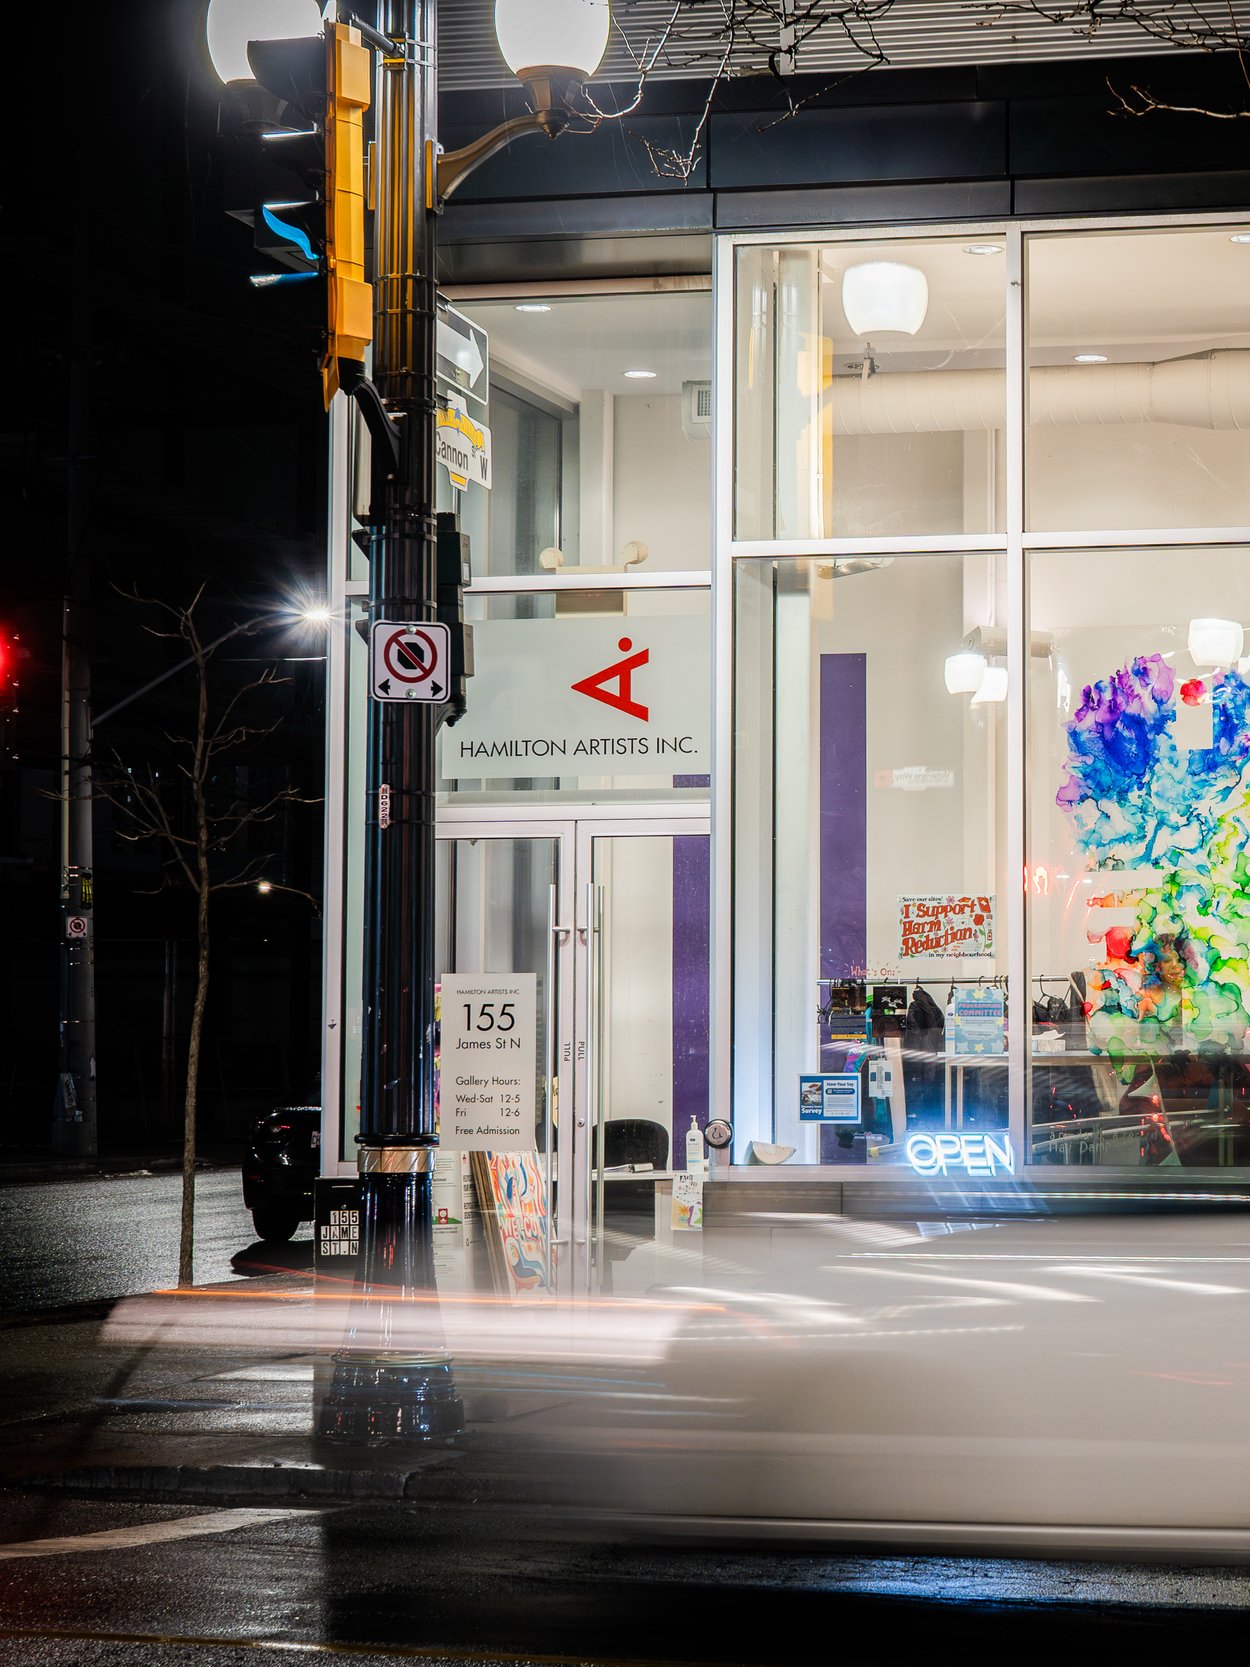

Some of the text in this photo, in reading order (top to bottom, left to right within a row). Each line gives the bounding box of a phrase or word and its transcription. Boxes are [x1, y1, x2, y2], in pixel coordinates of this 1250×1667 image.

[480, 456, 488, 480] W
[460, 736, 698, 758] HAMILTON ARTISTS INC.
[904, 900, 976, 920] I Support
[902, 920, 941, 937] Harm
[902, 926, 972, 956] Reduction
[851, 966, 895, 976] What's On:
[463, 1004, 515, 1031] 155
[456, 1038, 520, 1050] James St N
[456, 1076, 520, 1088] Gallery Hours:
[456, 1094, 520, 1103] Wed-Sat 12-5
[456, 1108, 520, 1117] Fri 12-6
[456, 1126, 520, 1135] Free Admission
[907, 1133, 1015, 1176] OPEN
[332, 1212, 358, 1224] 155
[322, 1227, 358, 1239] JAME
